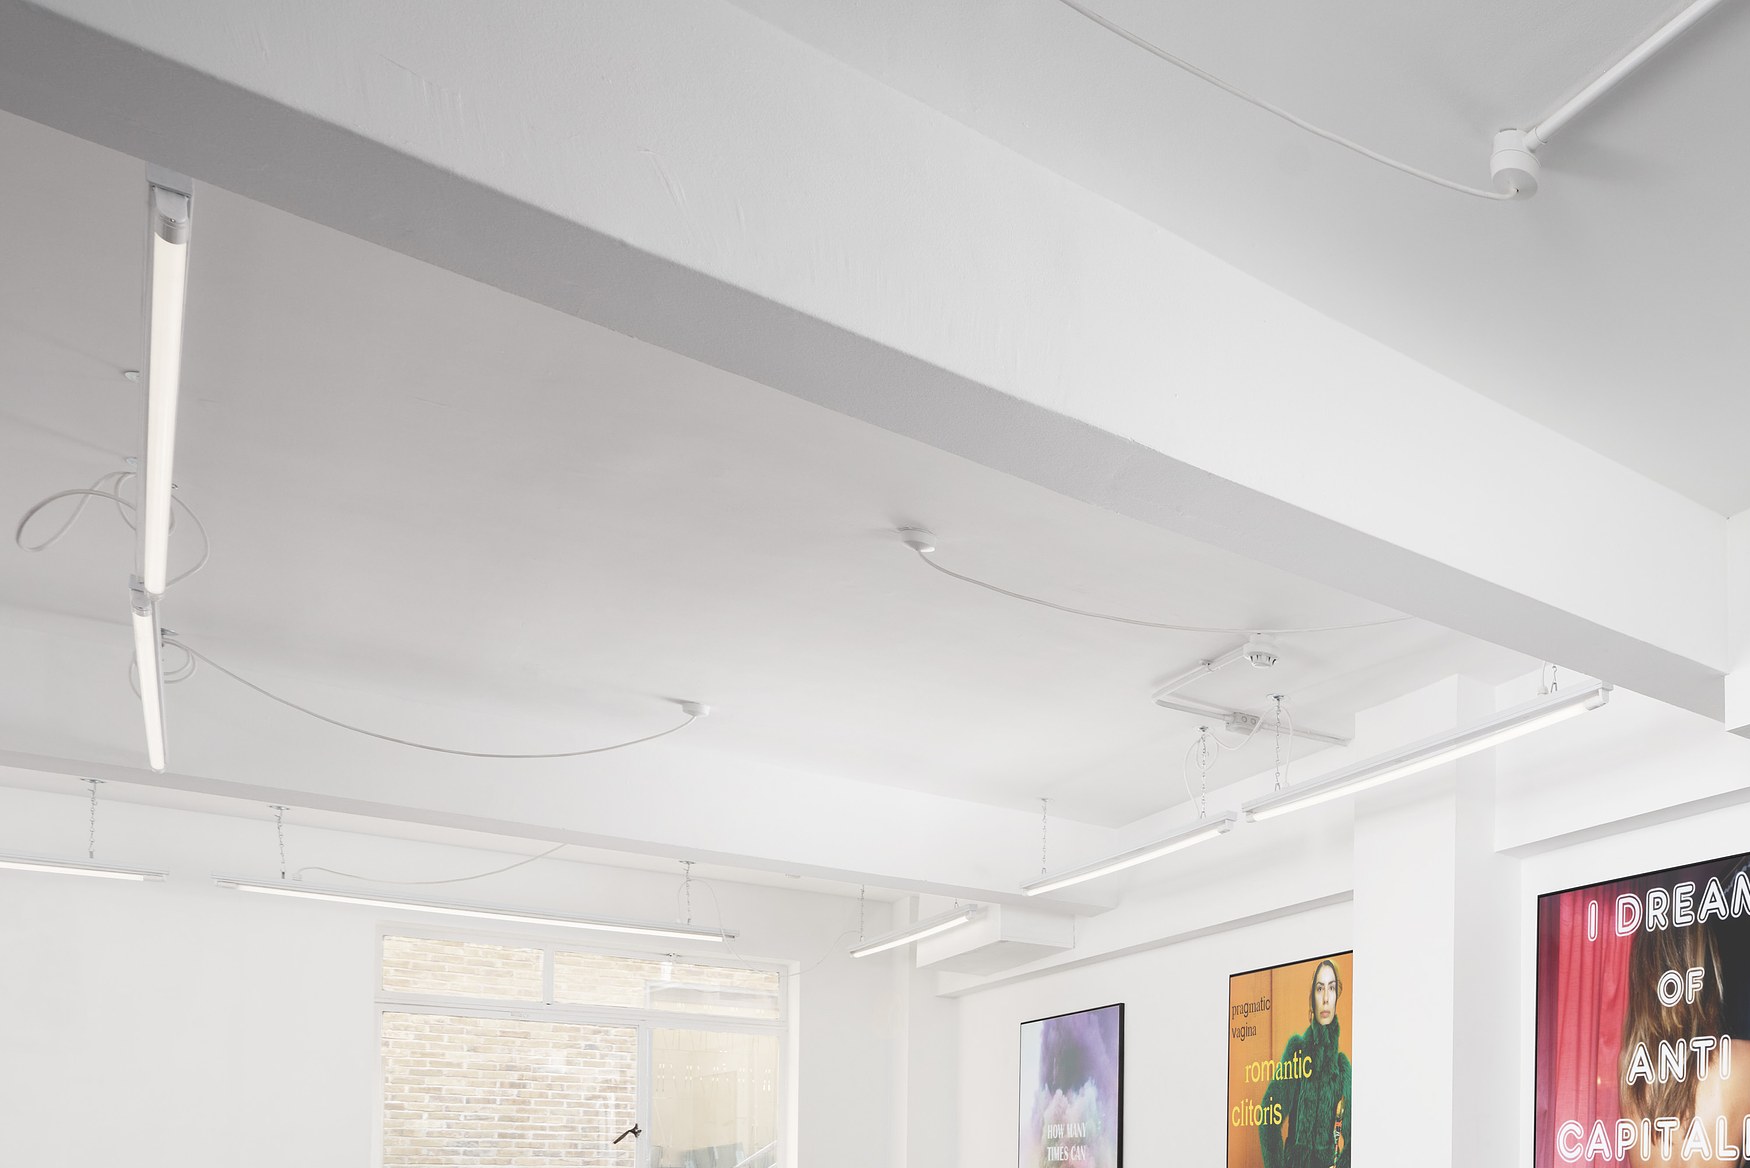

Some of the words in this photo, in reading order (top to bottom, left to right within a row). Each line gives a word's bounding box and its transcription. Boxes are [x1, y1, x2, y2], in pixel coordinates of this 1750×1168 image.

[1587, 899, 1599, 942] I
[1657, 966, 1705, 1007] OF
[1231, 996, 1271, 1020] pragmatic
[1231, 1022, 1257, 1042] vagina
[1244, 1049, 1313, 1083] romantic
[1626, 1035, 1732, 1085] ANTI
[1231, 1096, 1283, 1128] clitoris
[1047, 1123, 1064, 1140] HOW
[1066, 1122, 1086, 1138] MANY
[1046, 1145, 1069, 1161] TIMES
[1070, 1144, 1086, 1161] CAN
